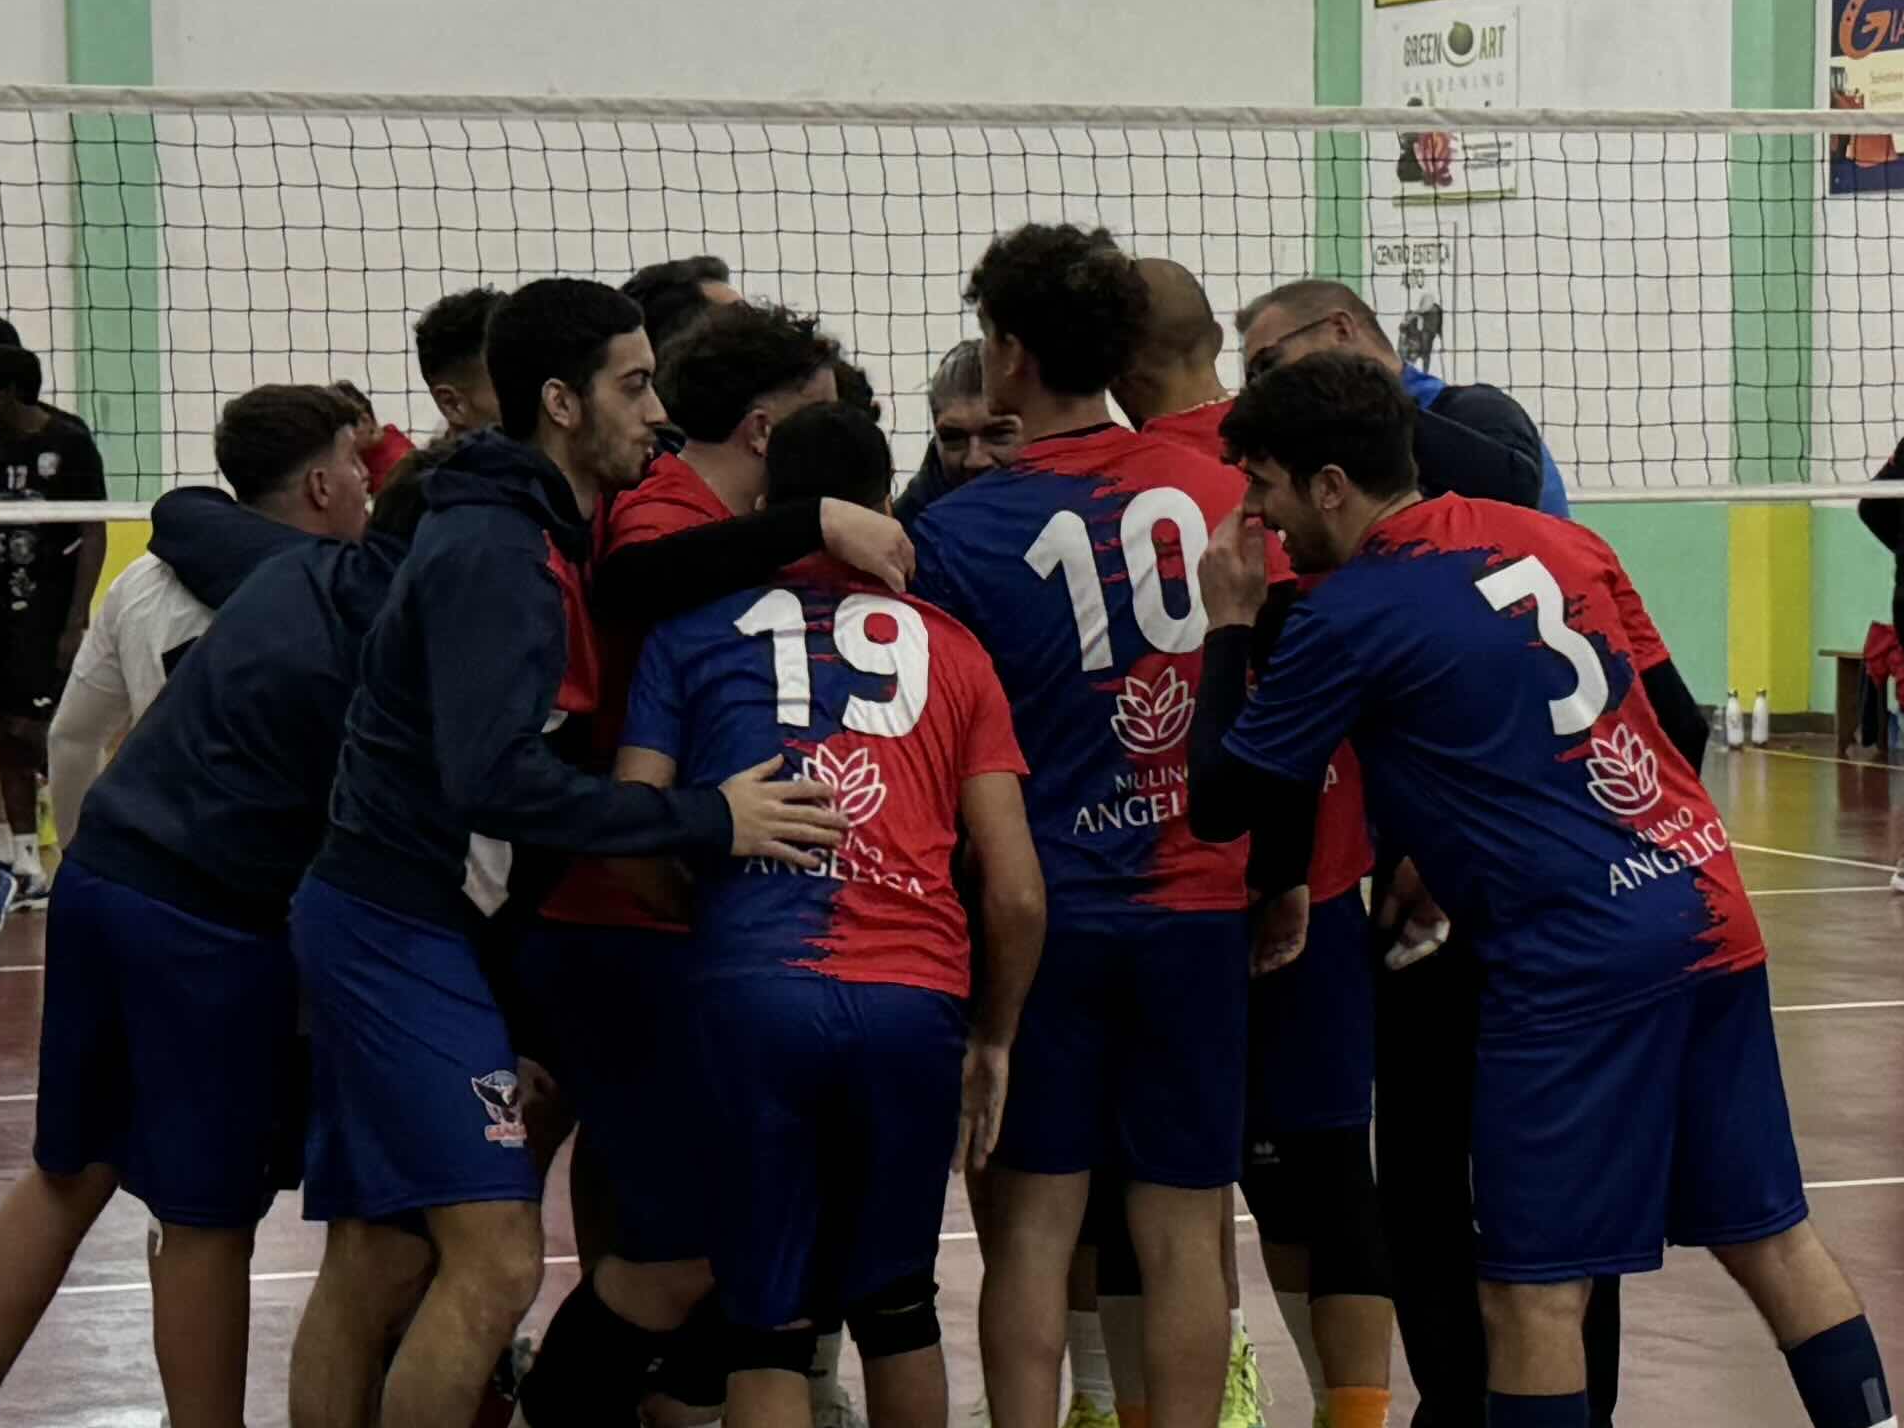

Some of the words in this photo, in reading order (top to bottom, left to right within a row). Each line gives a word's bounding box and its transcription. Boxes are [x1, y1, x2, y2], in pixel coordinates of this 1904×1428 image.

[1404, 31, 1442, 67] GREEN
[1478, 25, 1506, 60] ART
[1024, 486, 1209, 673] 10
[1474, 554, 1609, 737] 3
[734, 588, 930, 738] 19
[1072, 790, 1182, 836] ANGEL
